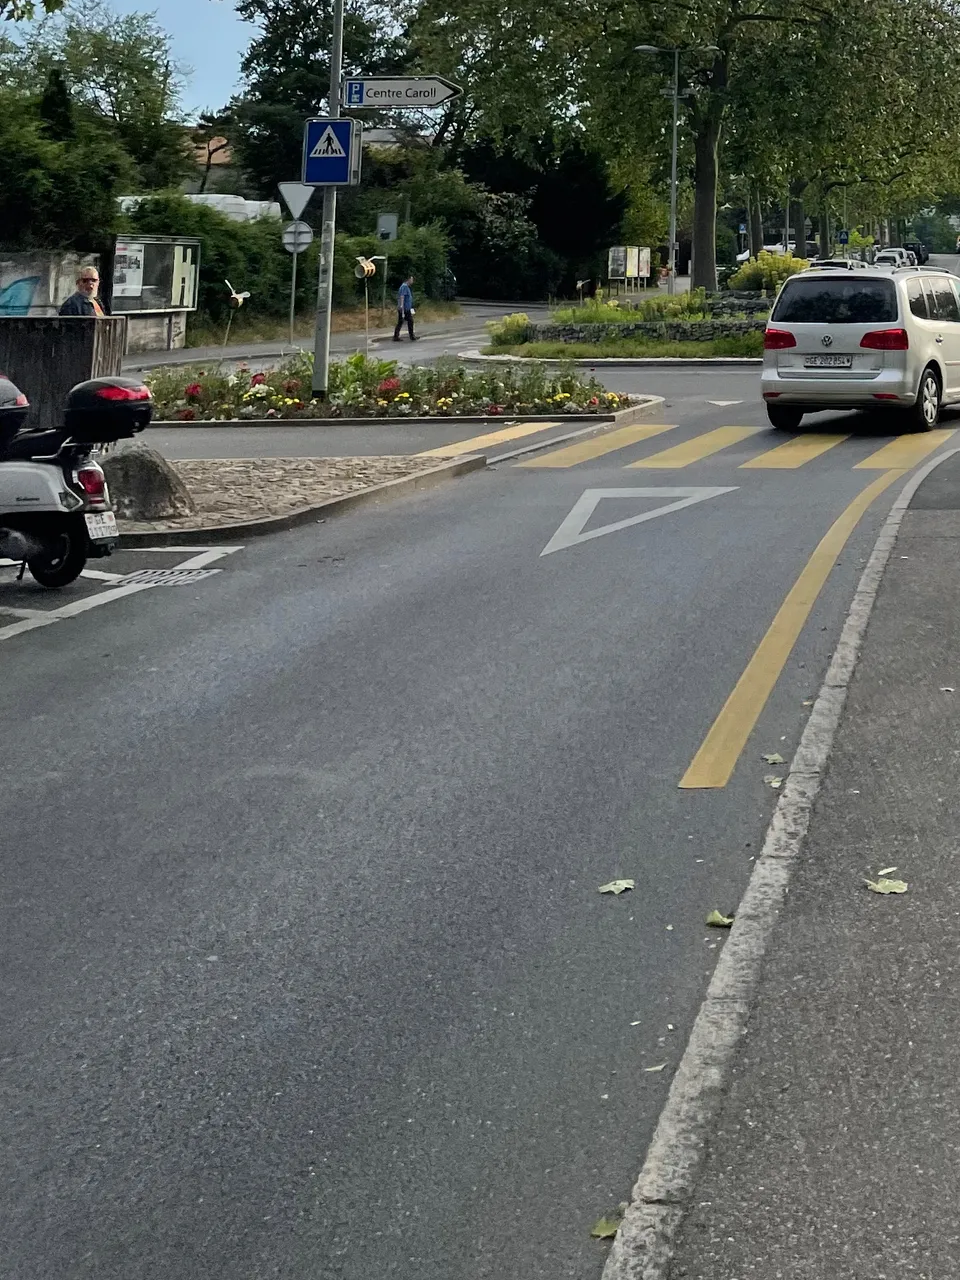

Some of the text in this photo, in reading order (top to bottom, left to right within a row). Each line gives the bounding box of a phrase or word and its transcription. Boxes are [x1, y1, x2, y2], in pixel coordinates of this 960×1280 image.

[352, 84, 360, 94] P
[366, 87, 437, 98] Centre Caroll
